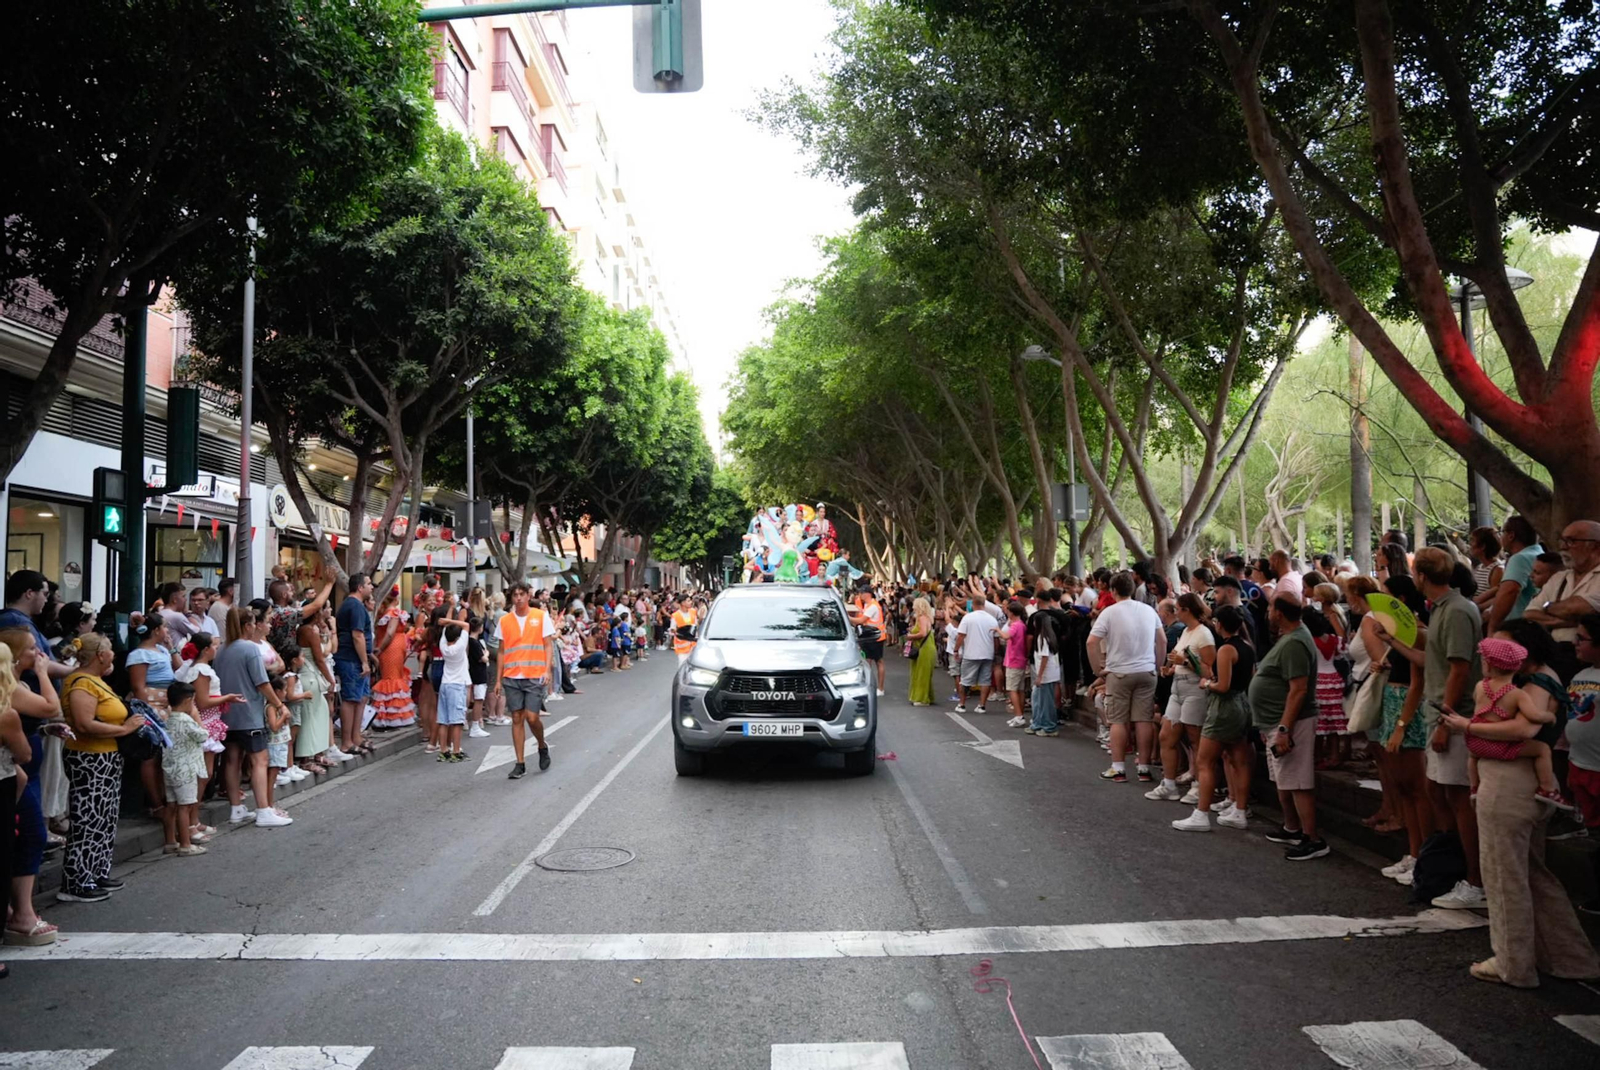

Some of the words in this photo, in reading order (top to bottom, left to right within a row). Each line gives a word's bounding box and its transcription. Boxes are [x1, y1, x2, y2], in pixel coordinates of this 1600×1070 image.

[751, 691, 795, 700] TOYOTA
[751, 725, 777, 735] 9602
[781, 725, 801, 735] MHP
